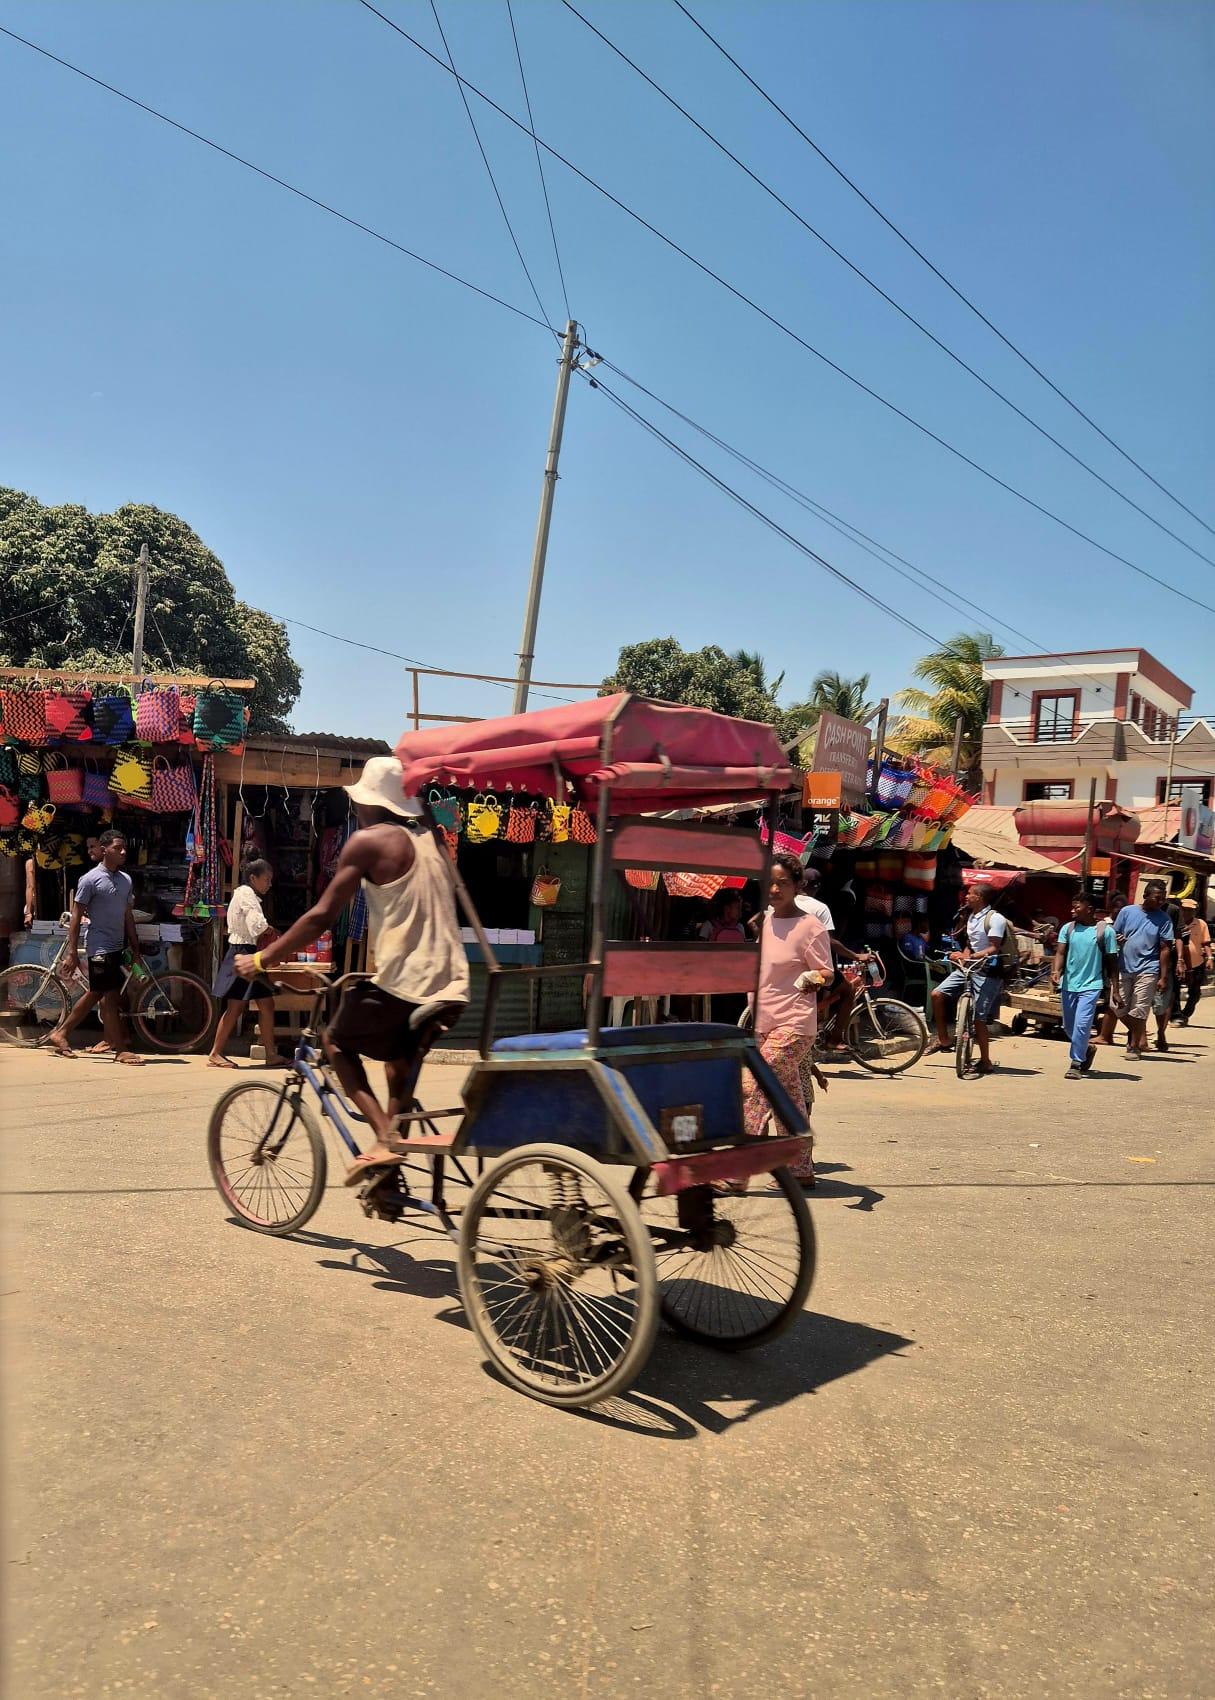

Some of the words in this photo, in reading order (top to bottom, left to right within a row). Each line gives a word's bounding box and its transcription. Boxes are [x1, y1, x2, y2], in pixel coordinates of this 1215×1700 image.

[824, 722, 846, 749] CASH
[847, 729, 868, 760] POINT
[807, 798, 837, 806] orange
